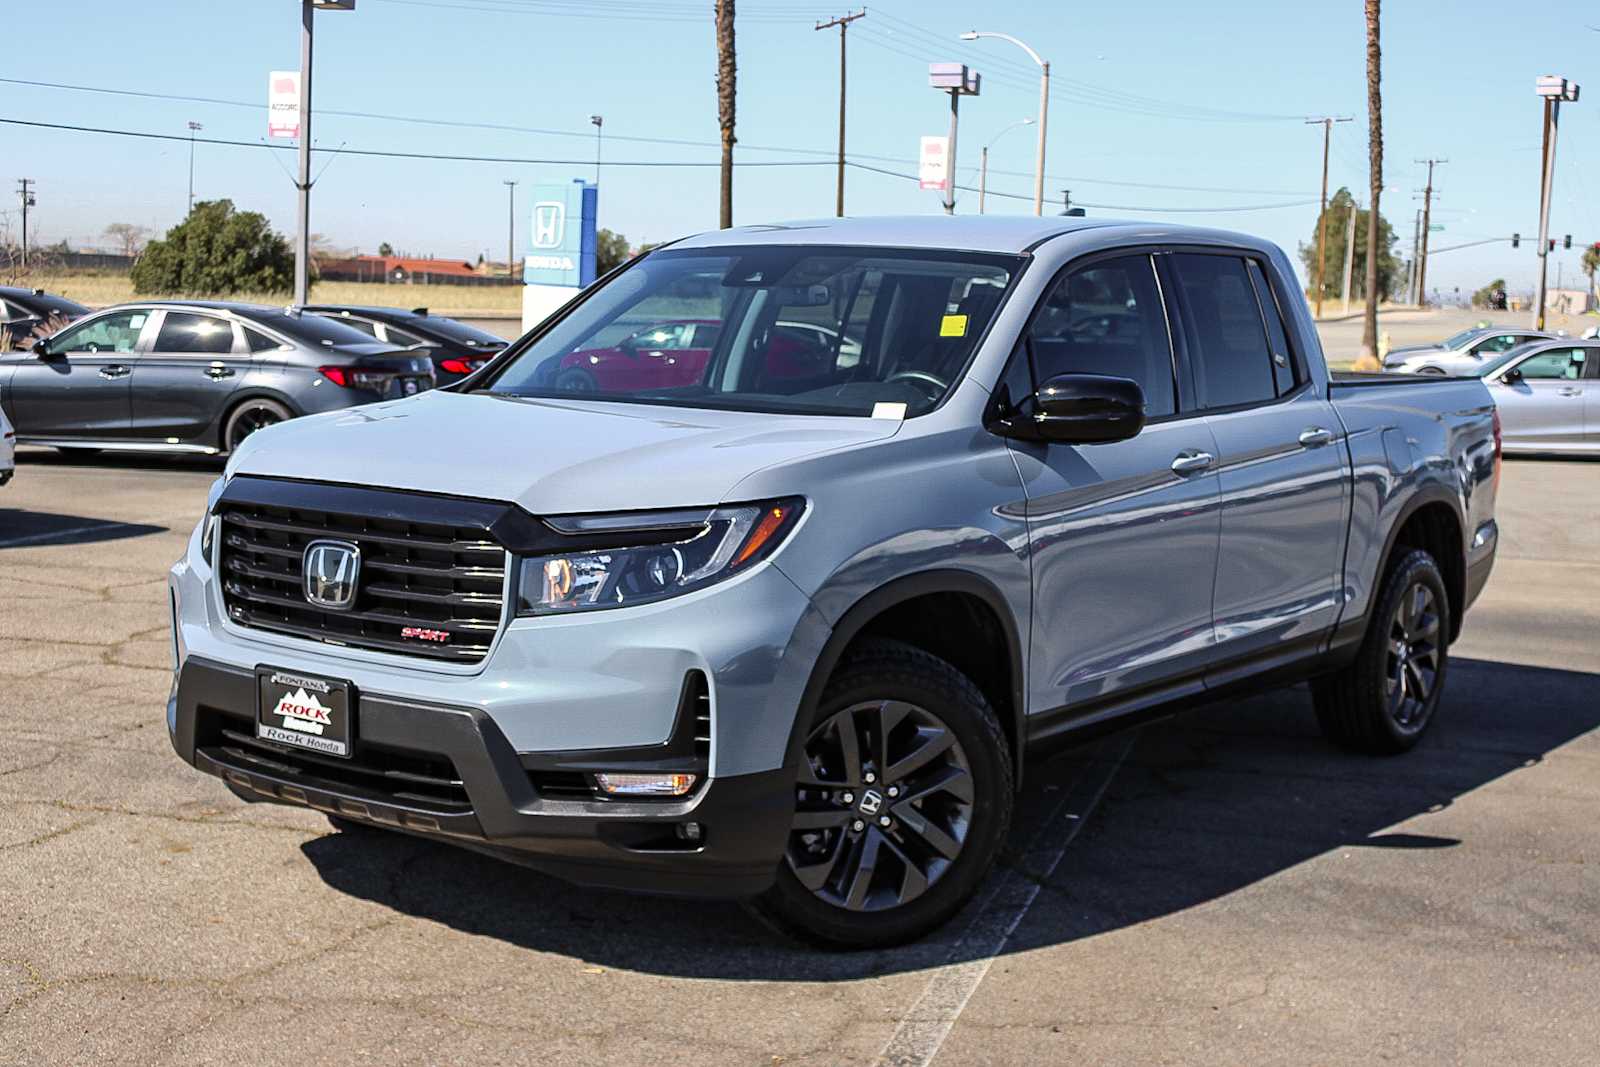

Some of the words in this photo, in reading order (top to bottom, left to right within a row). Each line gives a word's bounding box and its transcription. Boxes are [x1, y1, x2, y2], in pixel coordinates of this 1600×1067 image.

[400, 627, 450, 642] SPORT
[279, 675, 325, 690] FONTANA
[280, 702, 326, 720] ROCK
[267, 728, 303, 744] Rock
[306, 737, 339, 752] Honda
